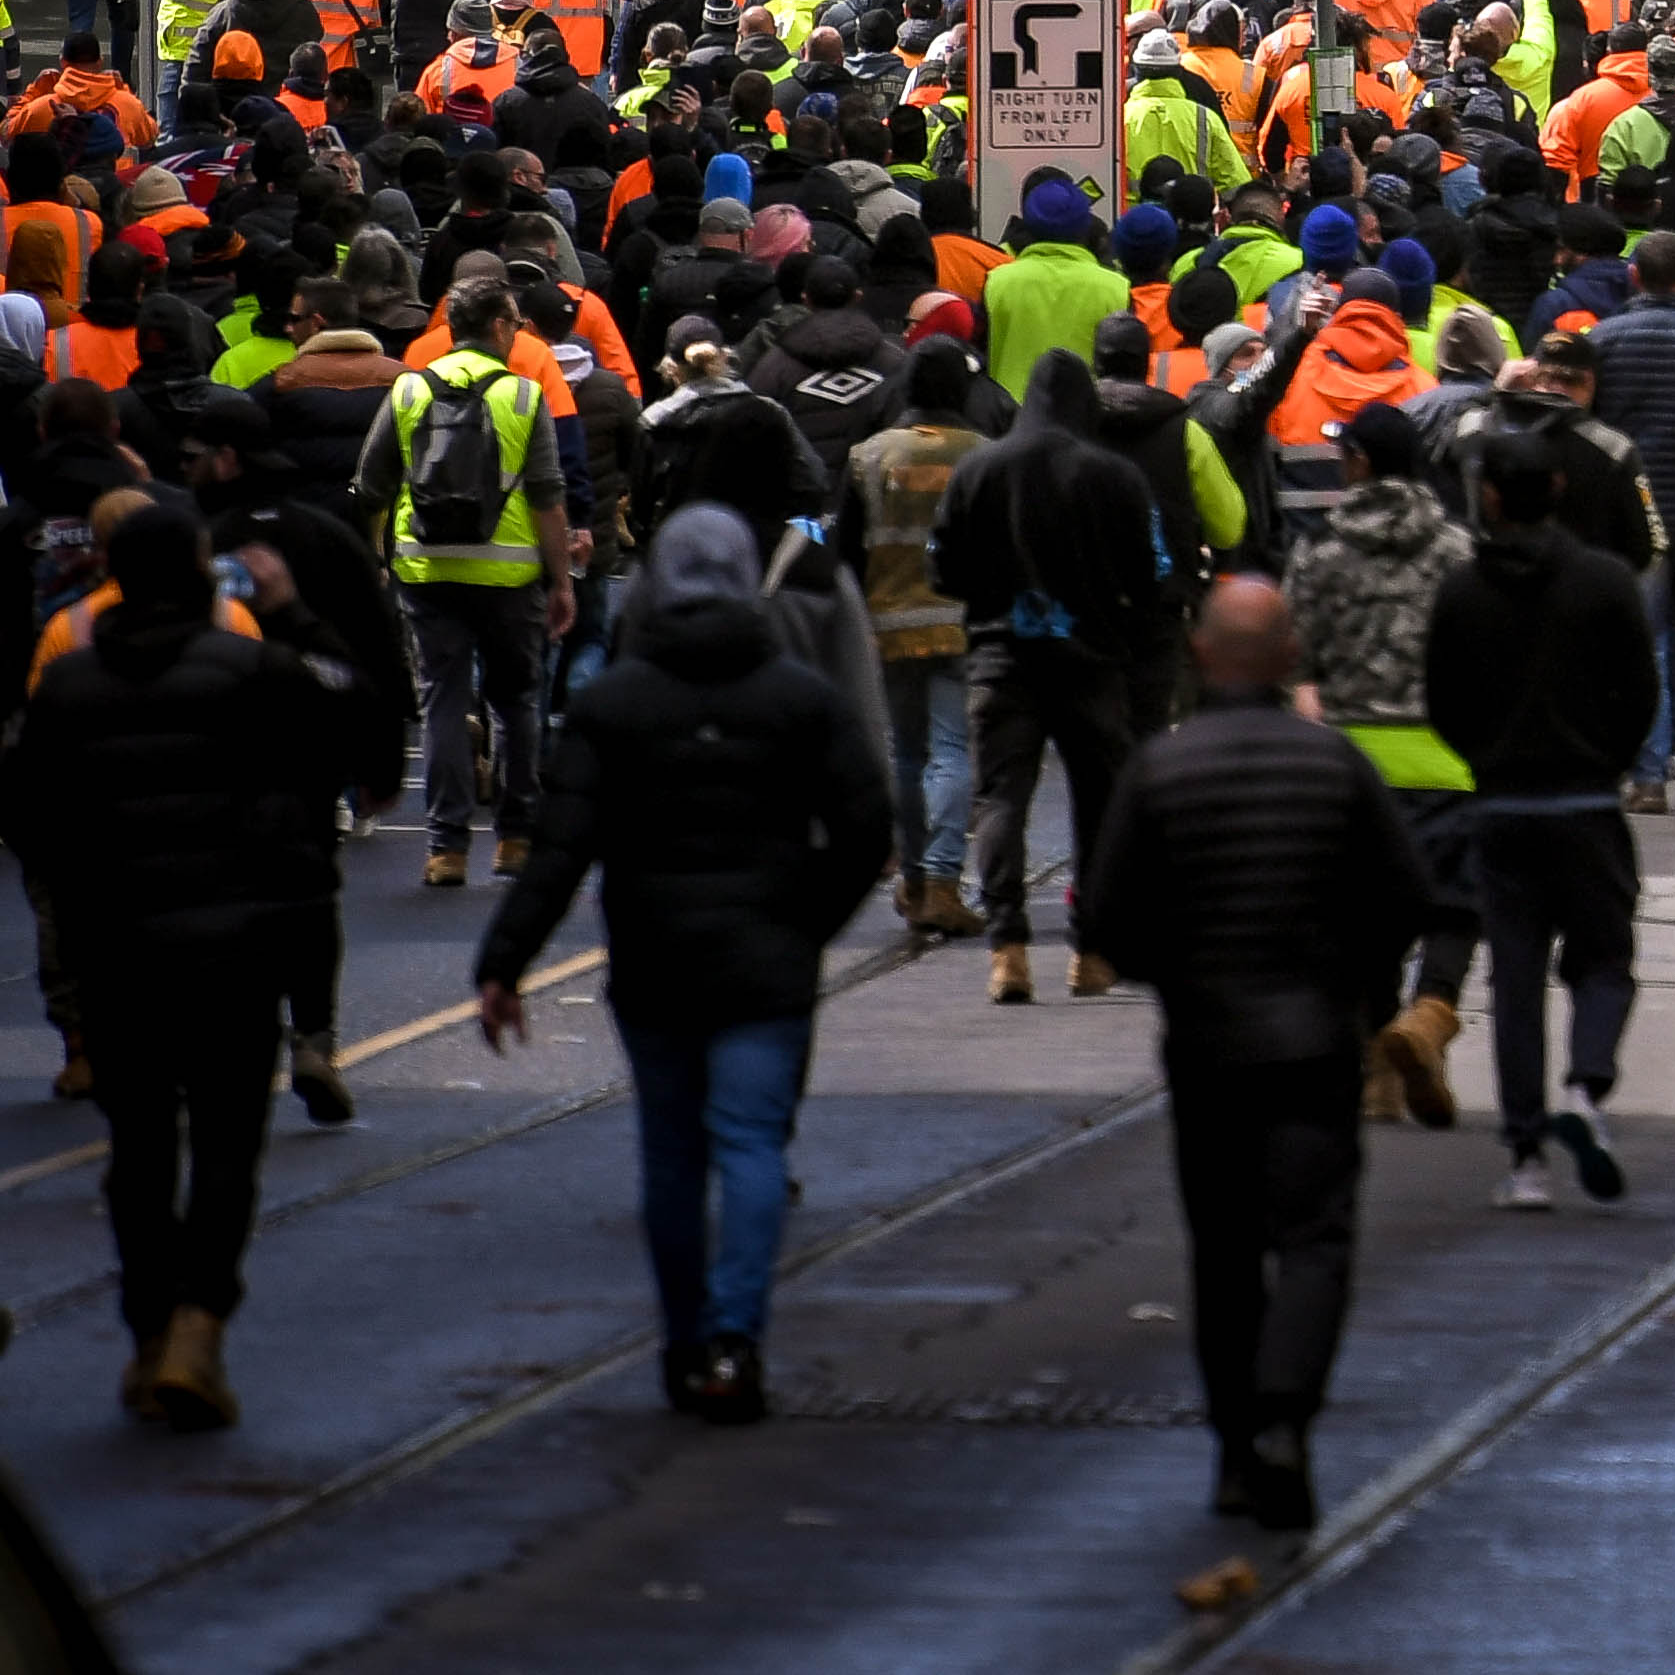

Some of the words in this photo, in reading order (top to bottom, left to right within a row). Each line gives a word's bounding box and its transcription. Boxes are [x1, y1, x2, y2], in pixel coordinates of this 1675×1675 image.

[994, 91, 1045, 106] RIGHT
[1053, 90, 1099, 106] TURN
[1000, 110, 1047, 125] FROM
[1051, 110, 1093, 124] LEFT
[1022, 128, 1070, 144] ONLY
